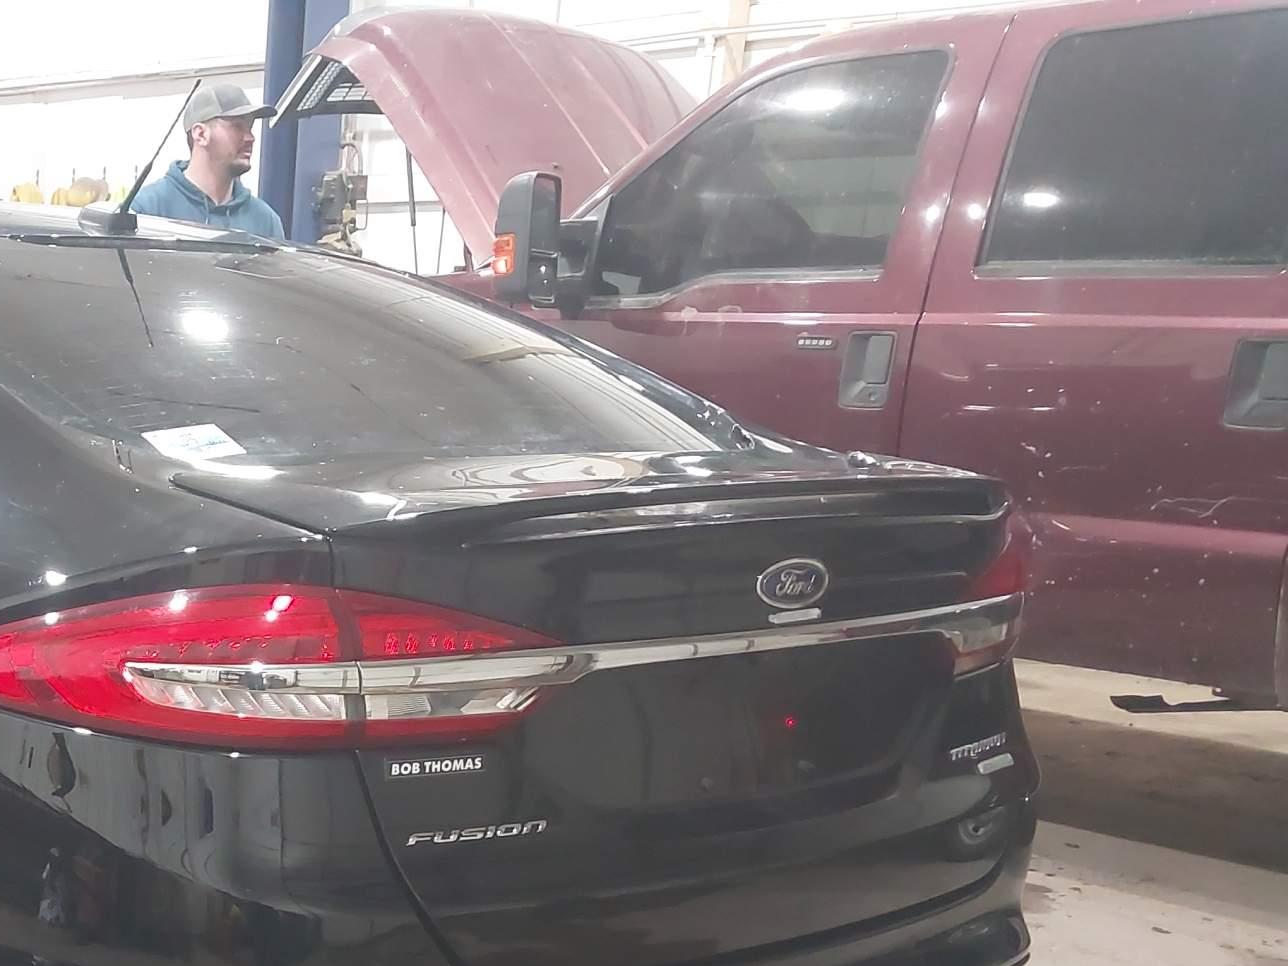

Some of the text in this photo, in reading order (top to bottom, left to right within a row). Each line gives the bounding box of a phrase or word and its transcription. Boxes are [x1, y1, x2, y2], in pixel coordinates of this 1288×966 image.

[775, 568, 816, 597] Ford
[391, 757, 482, 776] BOB THOMAS
[405, 819, 548, 847] FUSION
